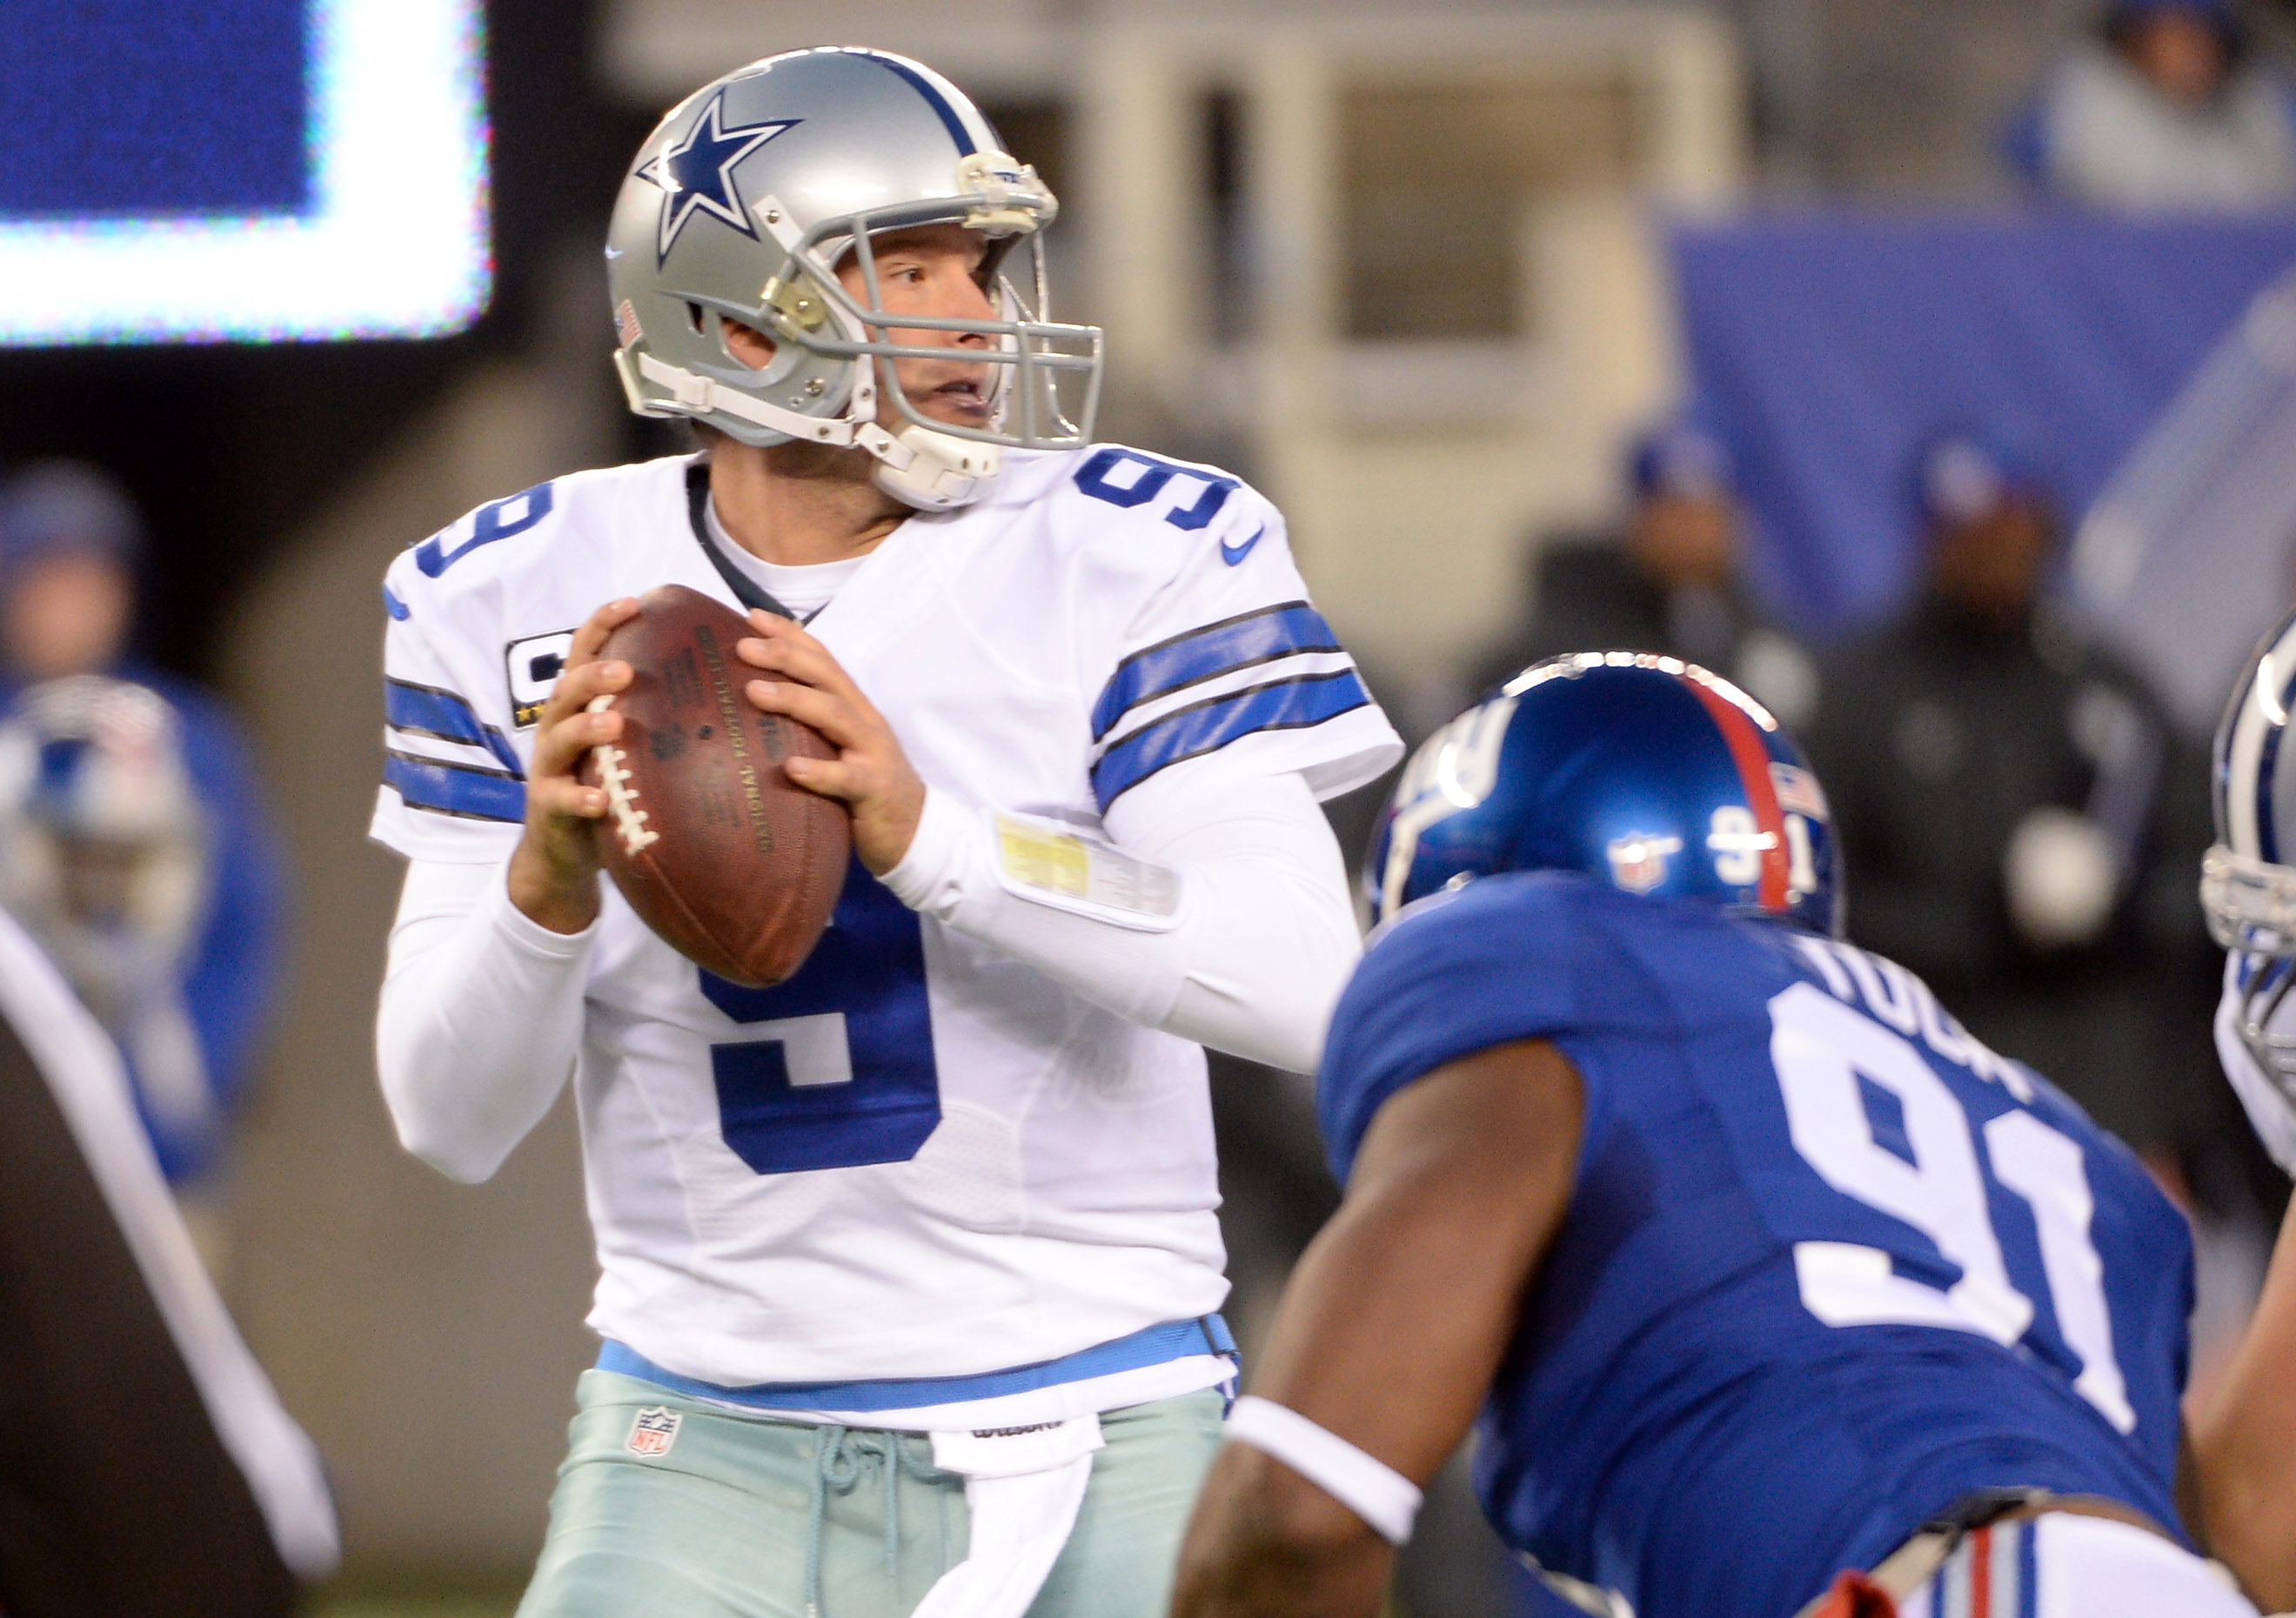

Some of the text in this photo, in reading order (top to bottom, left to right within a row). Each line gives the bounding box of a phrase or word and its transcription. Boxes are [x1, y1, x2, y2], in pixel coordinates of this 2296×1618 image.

[1073, 447, 1242, 531] 9
[713, 680, 749, 758] FOOTBALL
[738, 763, 773, 852] NATIONAL
[1708, 806, 1817, 894] 91
[699, 840, 943, 1175] 9
[1768, 980, 2136, 1434] 91
[633, 1428, 669, 1452] NFL
